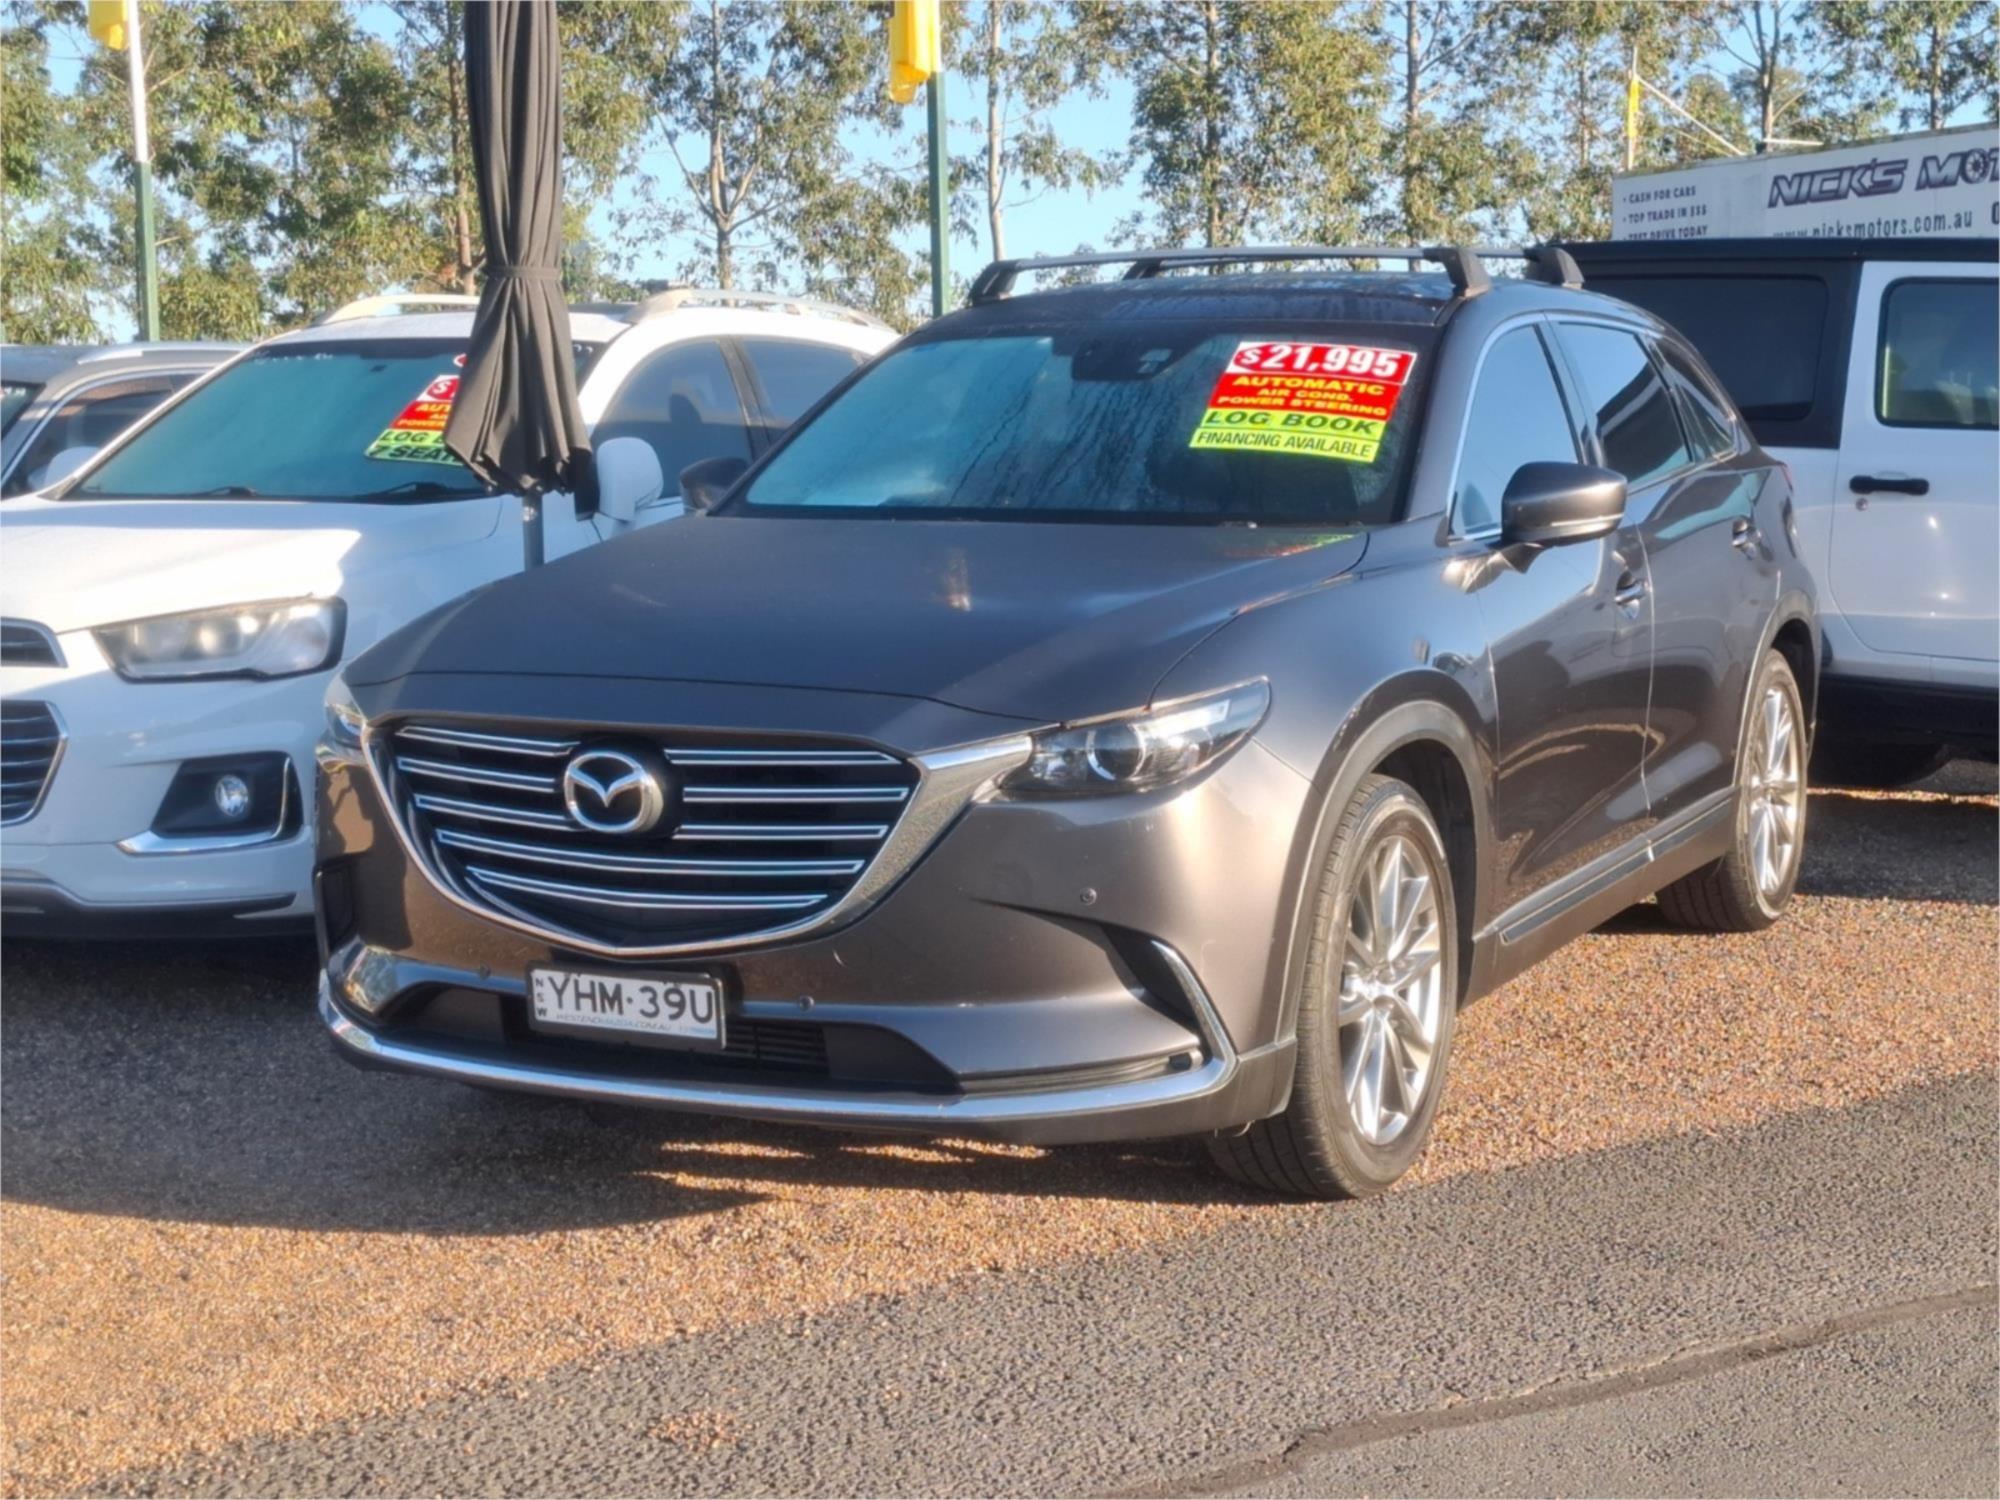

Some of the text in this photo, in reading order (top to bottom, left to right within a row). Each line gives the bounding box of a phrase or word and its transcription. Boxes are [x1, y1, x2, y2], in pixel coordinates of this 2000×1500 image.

[1768, 159, 1908, 208] NICK'S
[1629, 185, 1696, 204] CASH FOR CARS
[1628, 212, 1645, 223] TOP
[1647, 208, 1675, 221] TRADE
[1677, 207, 1687, 217] IN
[1773, 211, 1972, 238] wnicksmotors.com.au
[1678, 225, 1707, 238] TODAY
[1241, 344, 1401, 378] $21,995
[1232, 376, 1385, 395] AUTOMATIC
[1259, 388, 1354, 402] AIR COND.
[1218, 396, 1387, 416] POWER STEERING
[1205, 411, 1379, 434] LOG BOOK
[380, 431, 429, 442] LOG
[1197, 431, 1373, 457] FINANCING AVAILABLE
